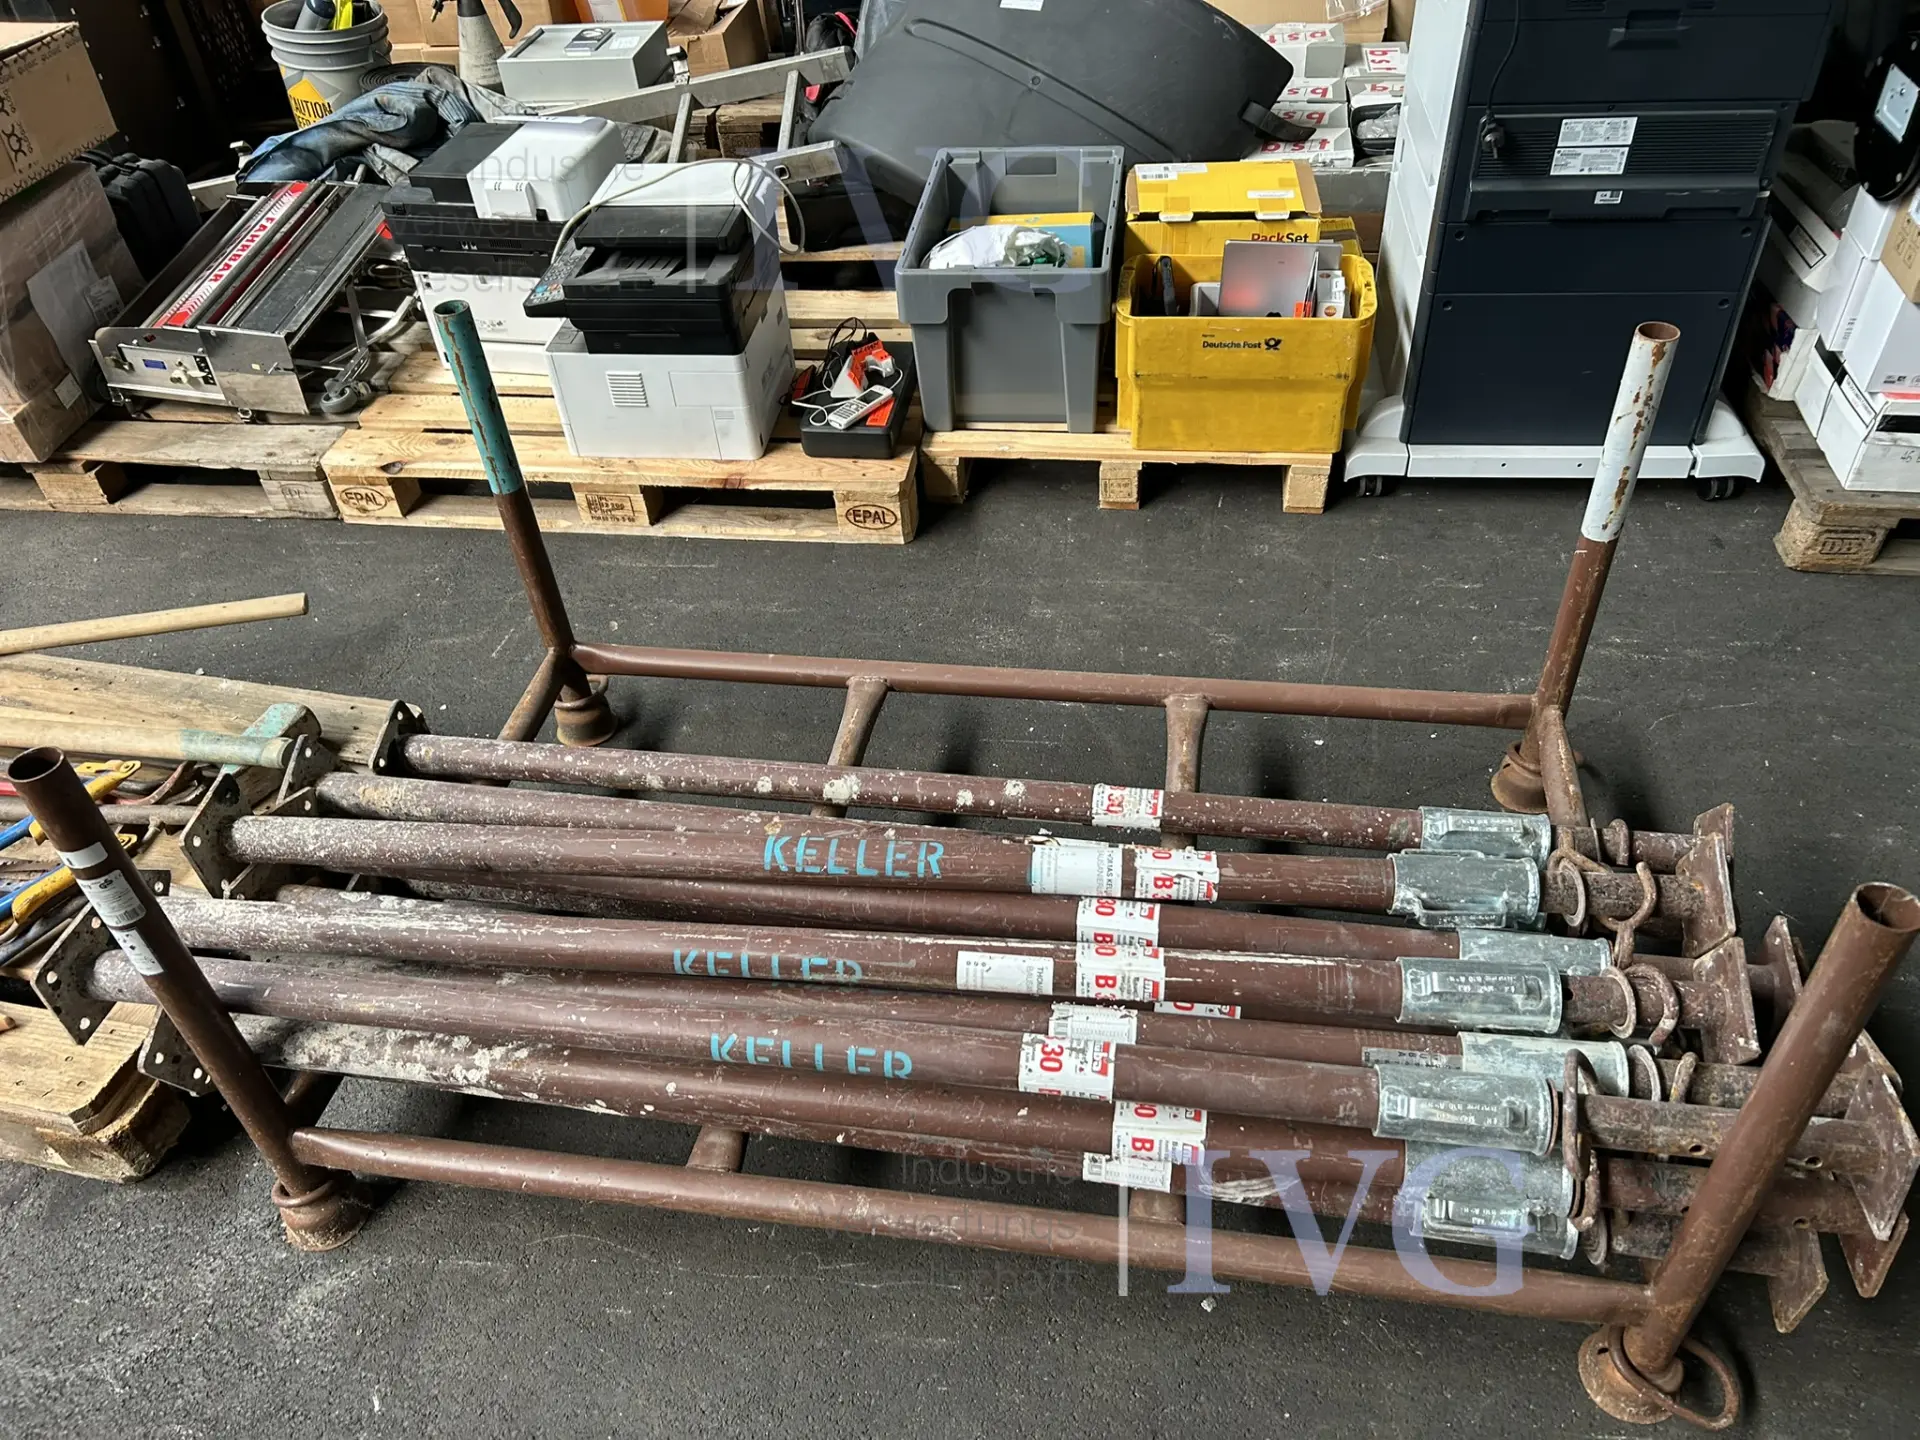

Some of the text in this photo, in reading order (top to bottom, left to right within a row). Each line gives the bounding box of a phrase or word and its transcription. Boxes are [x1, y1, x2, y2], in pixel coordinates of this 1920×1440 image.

[207, 216, 277, 283] FAHRBAR
[1202, 340, 1262, 349] Deutsche Post
[852, 510, 890, 526] EPAL
[763, 835, 945, 879] KELLER
[710, 1033, 913, 1080] KELLER
[1039, 1044, 1065, 1073] 30
